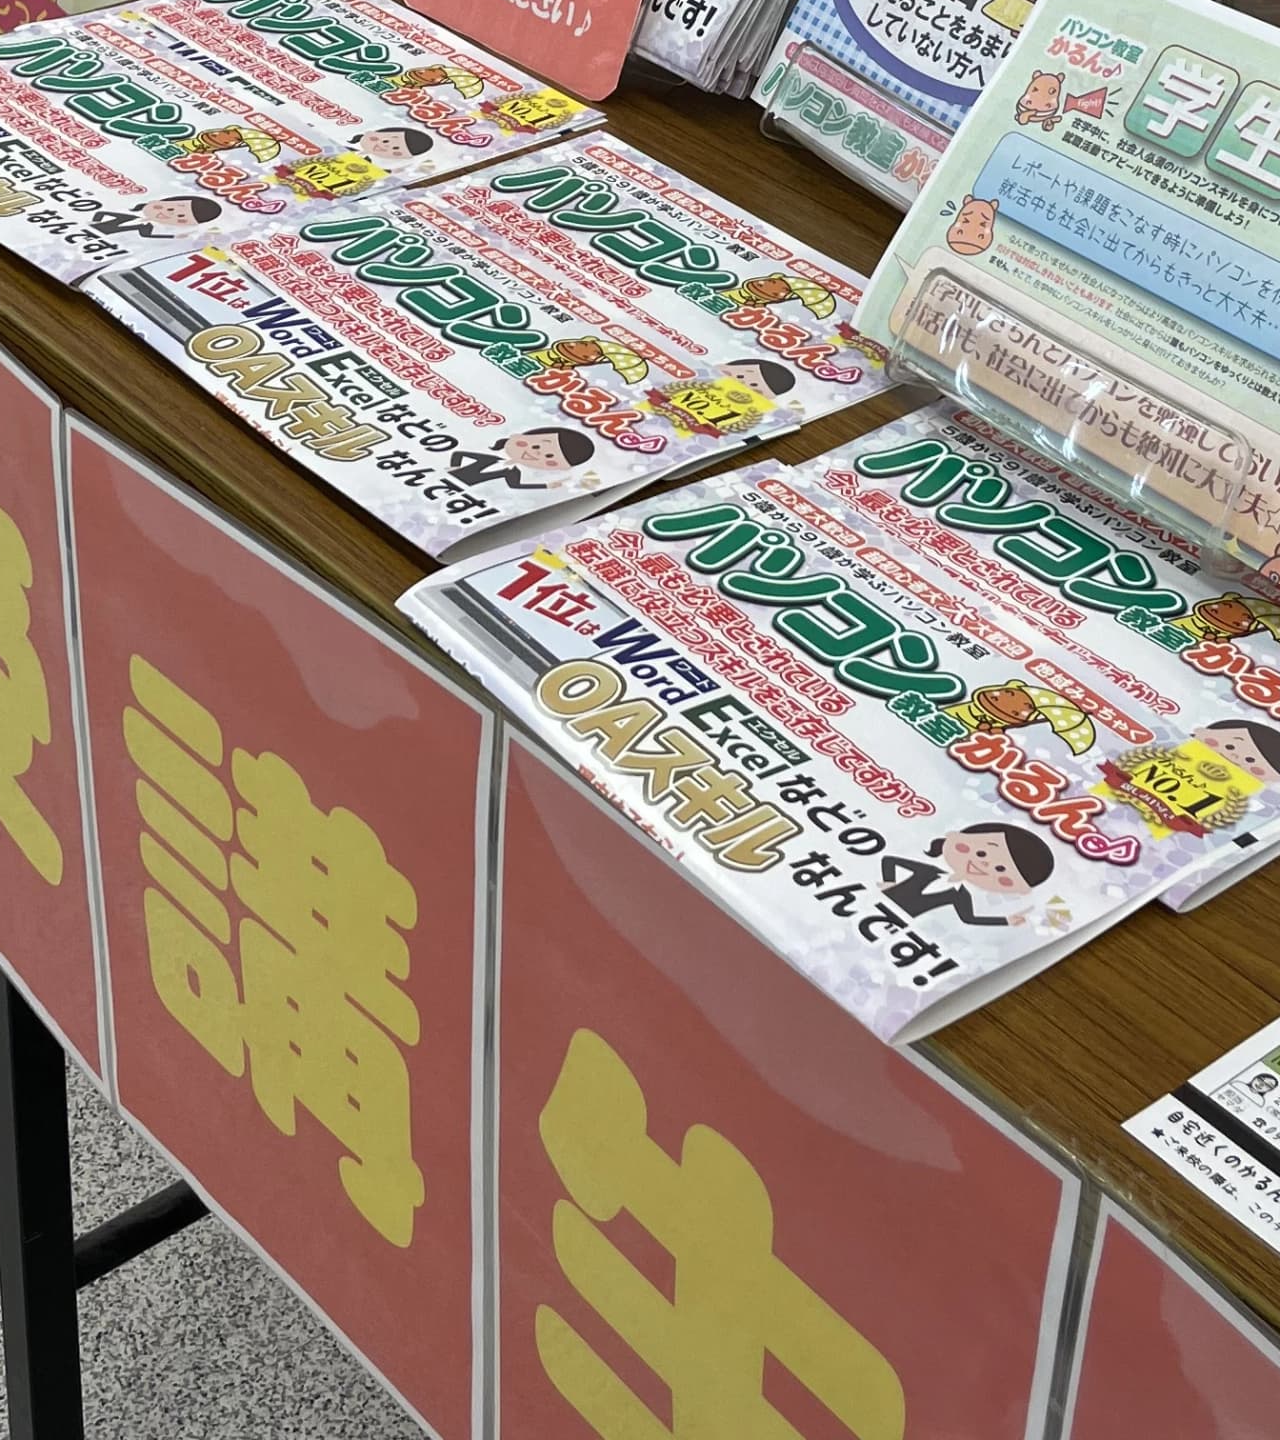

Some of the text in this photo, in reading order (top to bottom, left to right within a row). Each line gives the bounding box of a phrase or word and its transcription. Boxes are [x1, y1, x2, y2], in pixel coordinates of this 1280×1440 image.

[867, 3, 985, 86] していない方へ
[1060, 18, 1144, 65] パソコン教室
[302, 216, 548, 349] パソコン
[491, 166, 739, 289] パソコン
[167, 253, 249, 310] 1位は
[242, 296, 324, 359] Word
[855, 439, 1187, 617] パソコン
[645, 504, 966, 704] パソコン
[885, 692, 968, 745] 教室
[496, 560, 601, 637] 1位は
[592, 618, 701, 706] Word
[682, 695, 786, 784] Excel
[778, 772, 886, 856] などの
[534, 660, 802, 872] OAスキル
